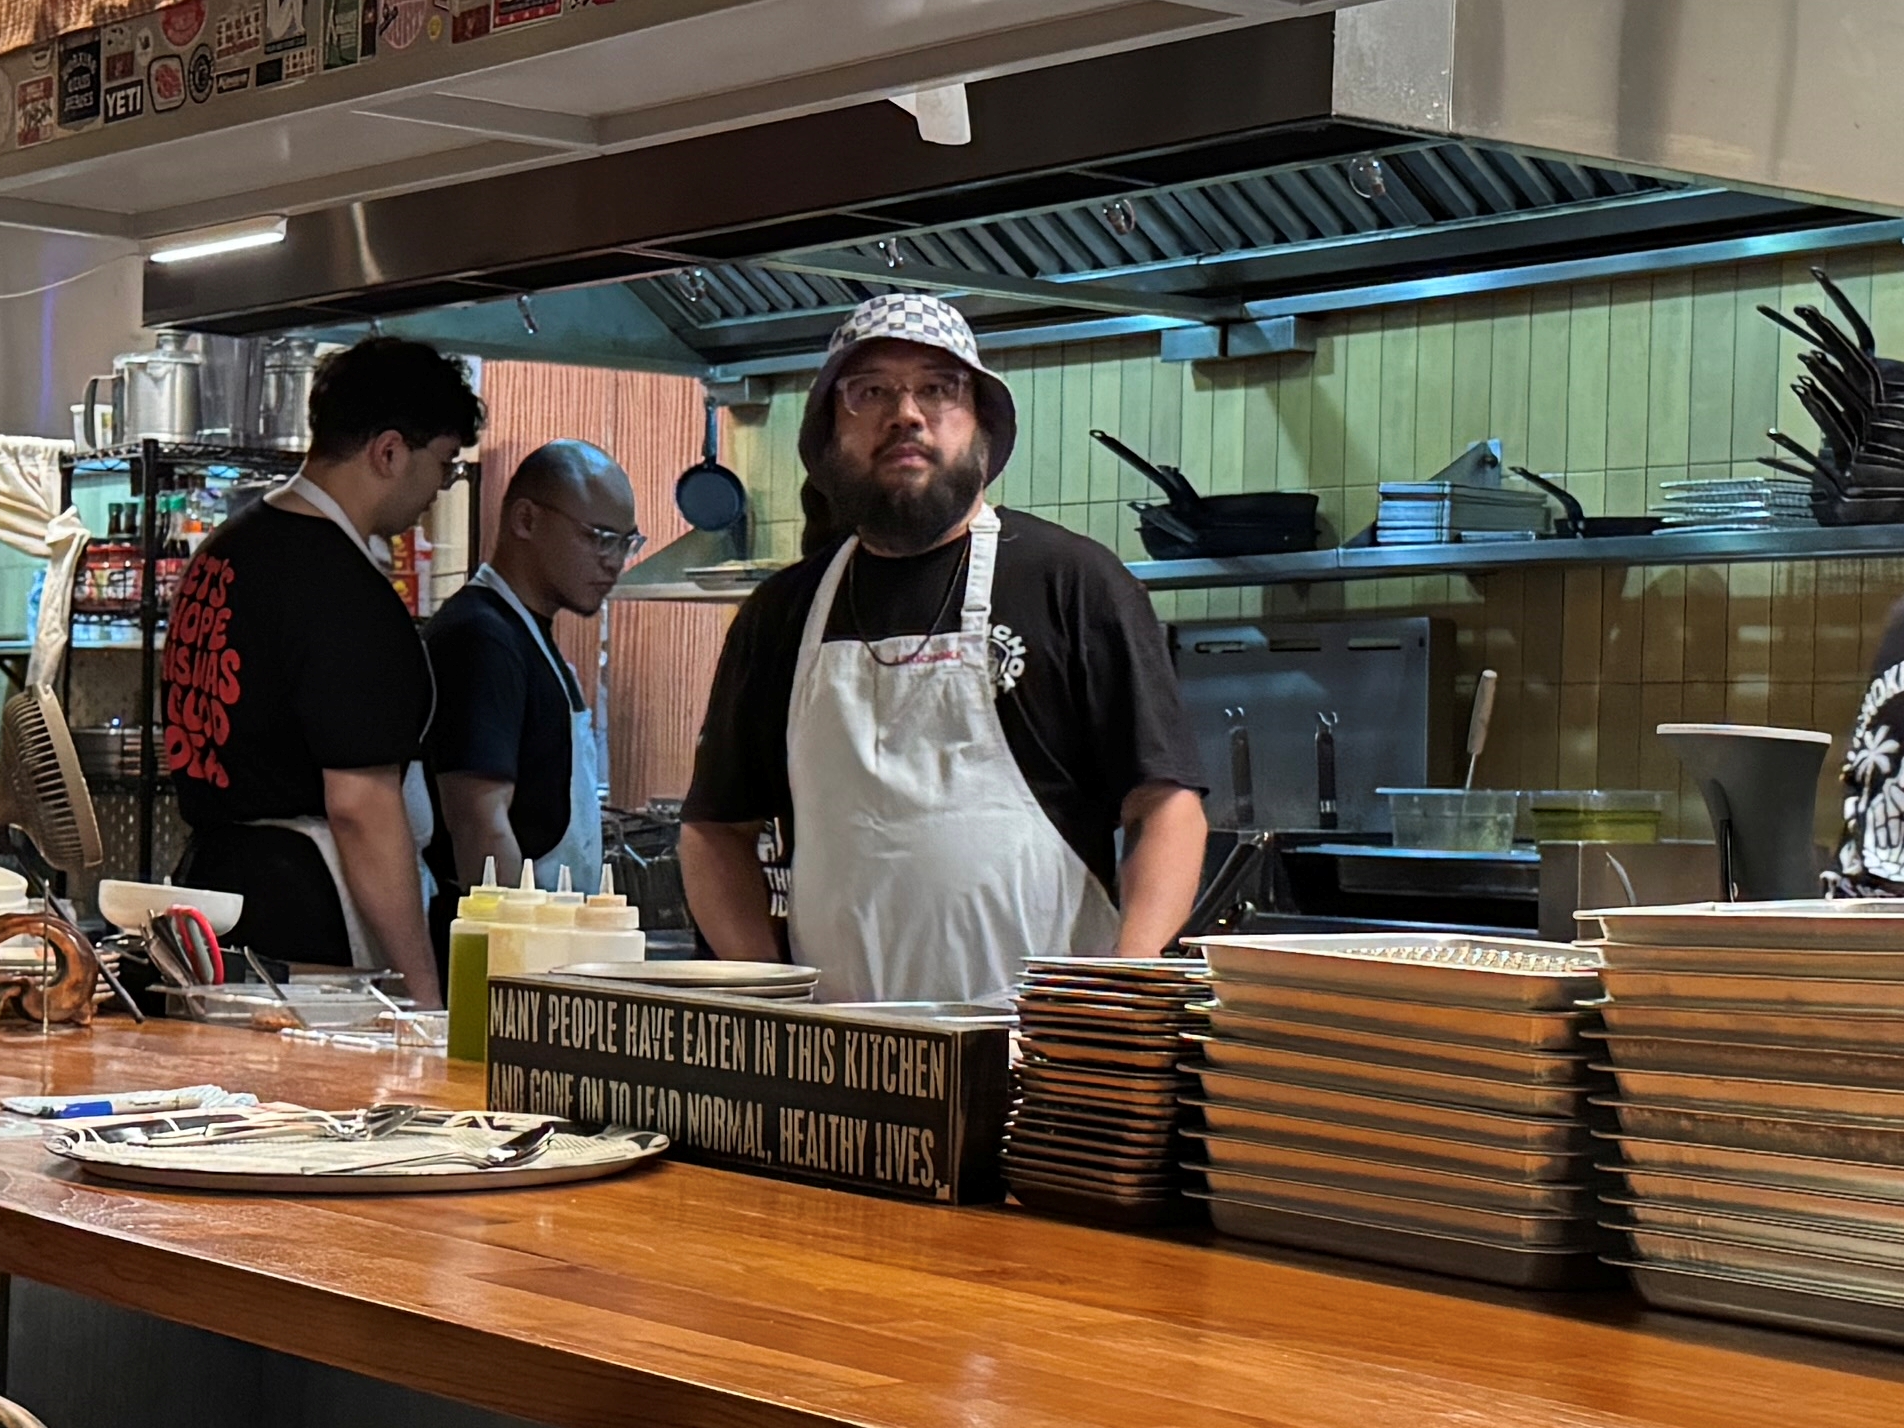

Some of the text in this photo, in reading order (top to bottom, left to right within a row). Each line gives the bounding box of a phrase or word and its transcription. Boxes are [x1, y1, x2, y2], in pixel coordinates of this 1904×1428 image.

[106, 86, 141, 117] YETI
[182, 553, 235, 608] ET'S
[490, 986, 946, 1101] MANY PEOPLE HAVE EATEN IN THIS KITCHEN
[491, 1062, 943, 1189] AND GONE ON TO LEAD NORMAL, HEALTHY LIVES.
